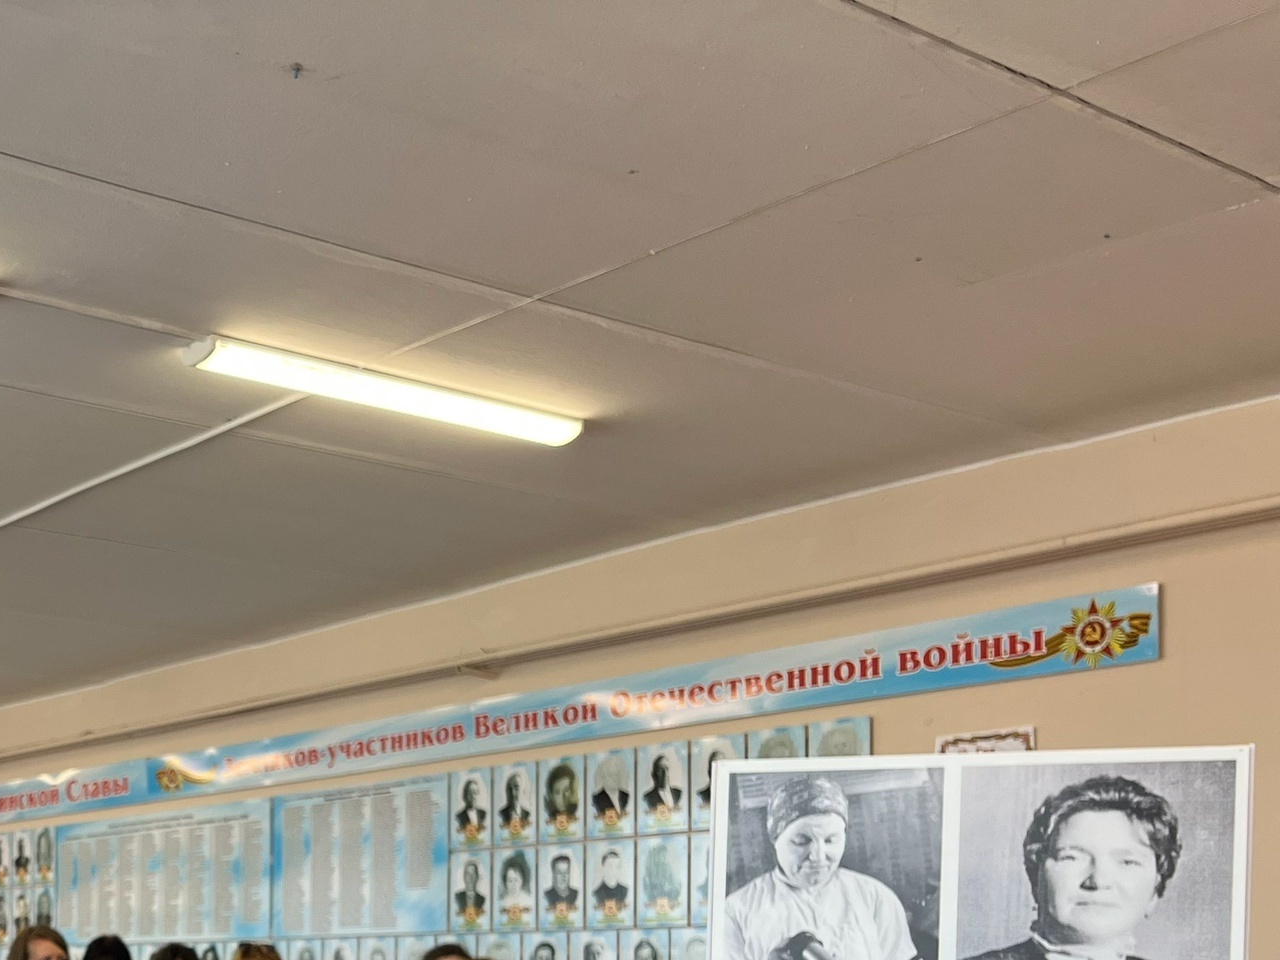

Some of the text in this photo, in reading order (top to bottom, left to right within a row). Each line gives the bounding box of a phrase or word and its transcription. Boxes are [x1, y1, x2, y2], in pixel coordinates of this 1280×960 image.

[473, 697, 599, 740] Великой
[609, 648, 883, 719] Отечественной
[896, 627, 1048, 675] войны
[66, 776, 130, 803] Славы
